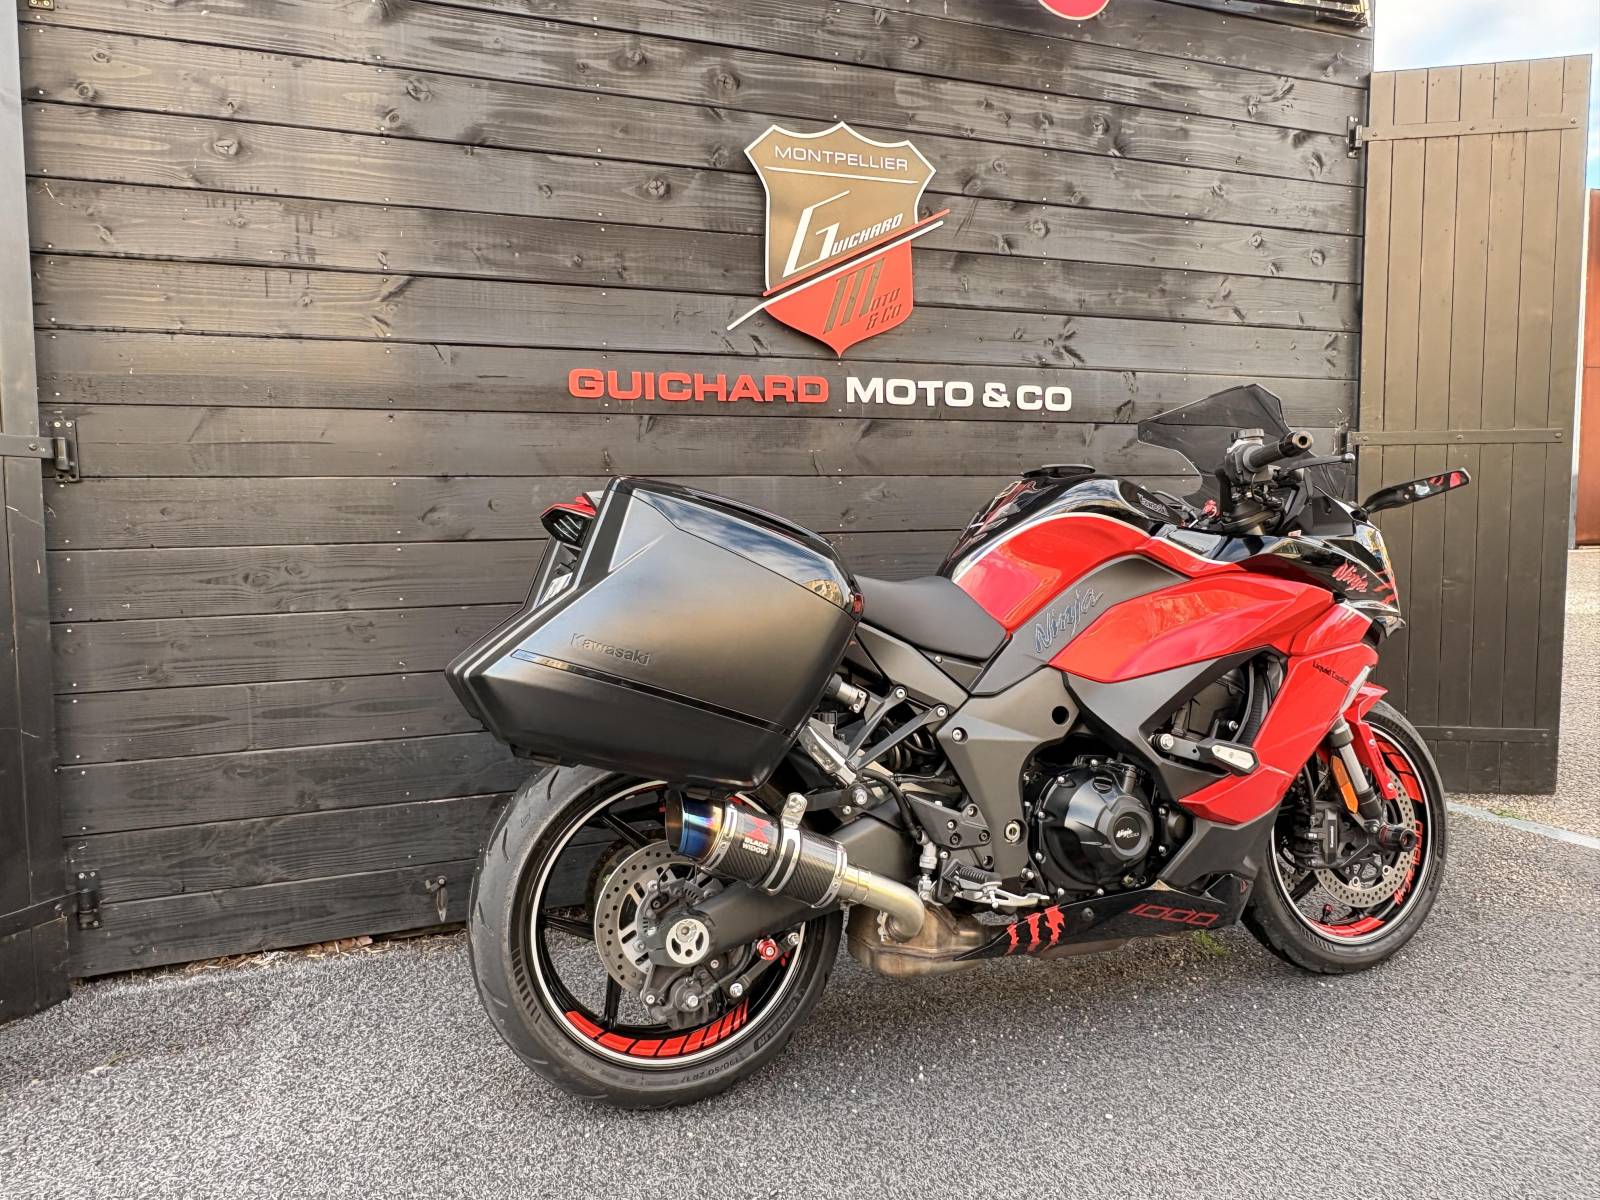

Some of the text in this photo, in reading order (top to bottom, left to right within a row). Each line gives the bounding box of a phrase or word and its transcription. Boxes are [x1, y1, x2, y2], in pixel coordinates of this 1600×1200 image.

[774, 145, 909, 172] MONTPELLIER
[782, 190, 904, 279] GUICHARD
[568, 368, 830, 404] GUICHARD
[846, 377, 974, 408] MOTO
[1332, 558, 1370, 593] Ninja
[1034, 586, 1104, 654] Ninja
[570, 632, 652, 666] Kawasaki
[742, 842, 769, 856] WIDOW
[744, 836, 770, 850] BLACK
[1129, 903, 1219, 927] 1000
